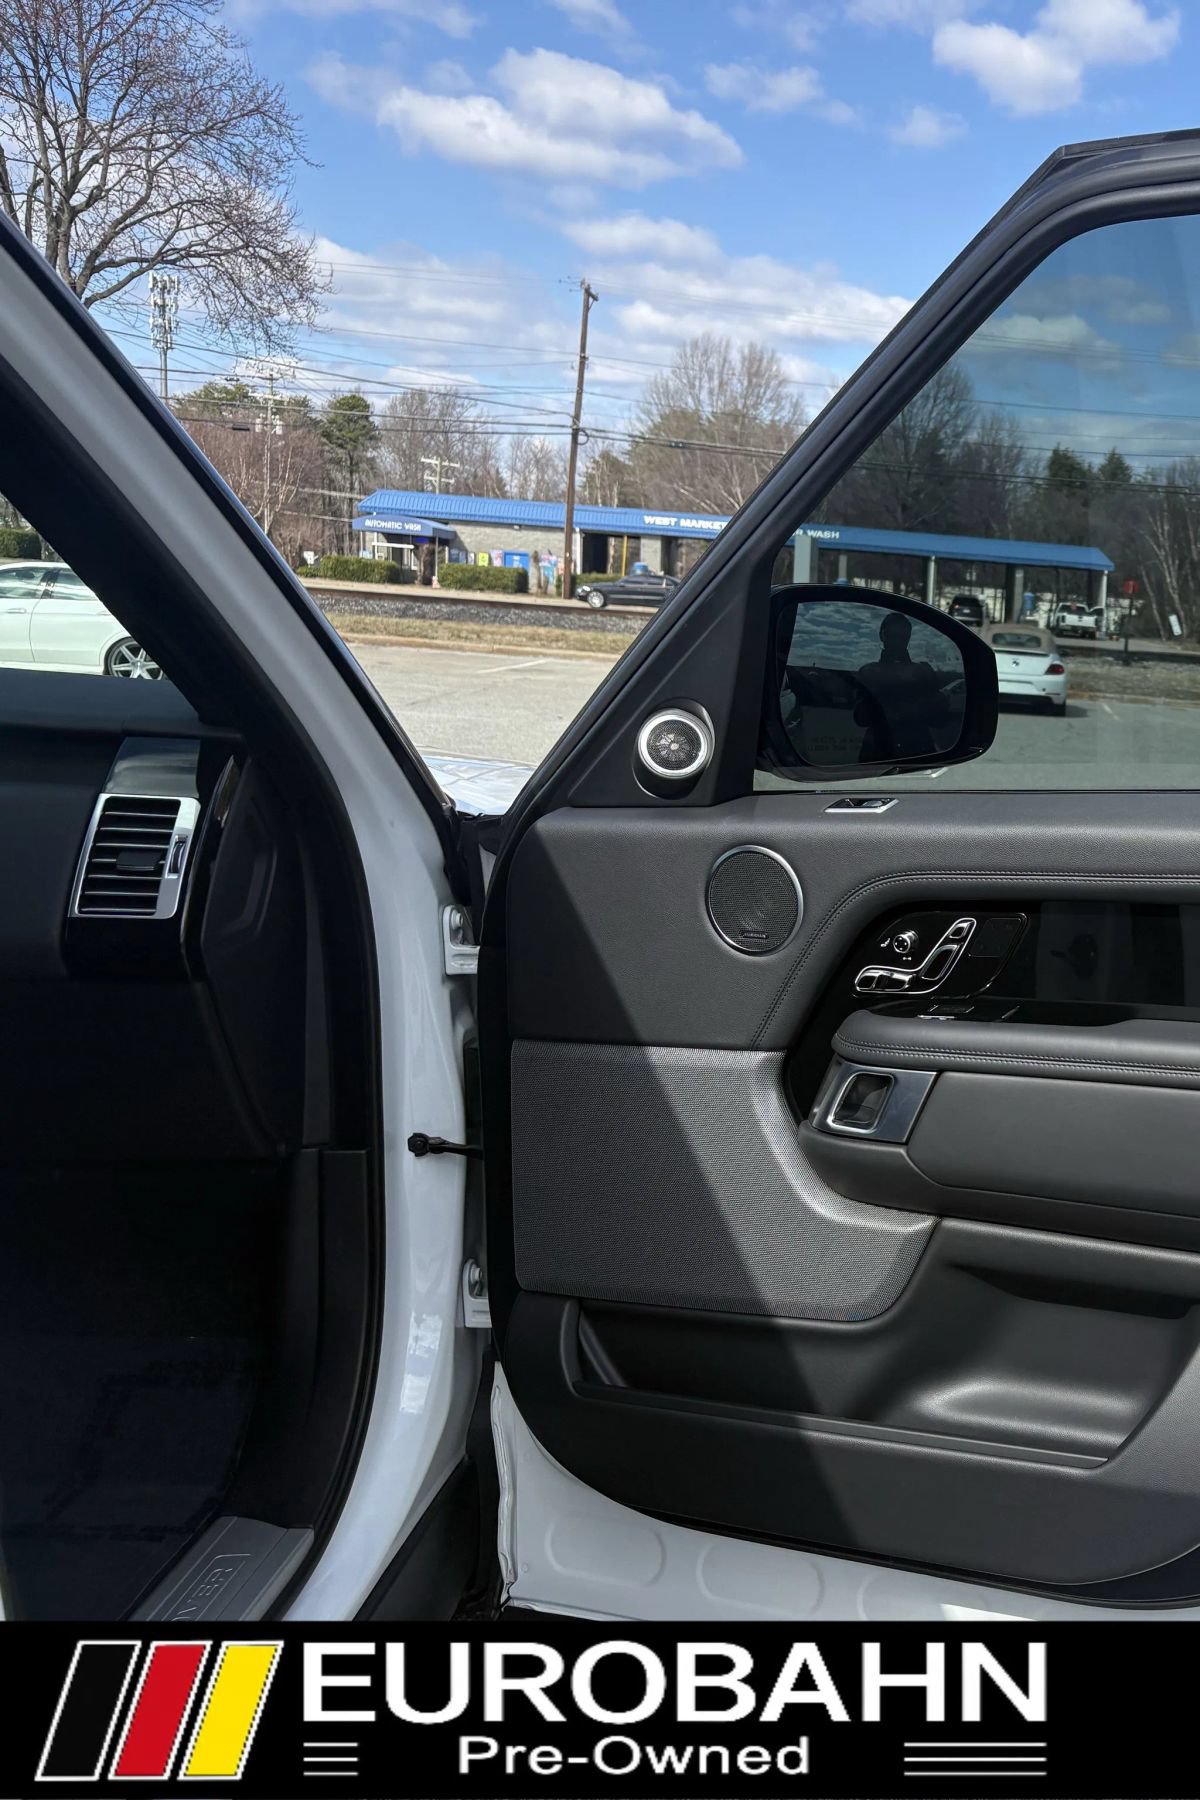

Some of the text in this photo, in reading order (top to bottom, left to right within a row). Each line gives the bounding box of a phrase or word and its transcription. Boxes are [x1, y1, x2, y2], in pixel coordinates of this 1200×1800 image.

[364, 518, 422, 532] AUTOMATIC WASH
[643, 515, 677, 526] WEST
[807, 529, 840, 539] WASH
